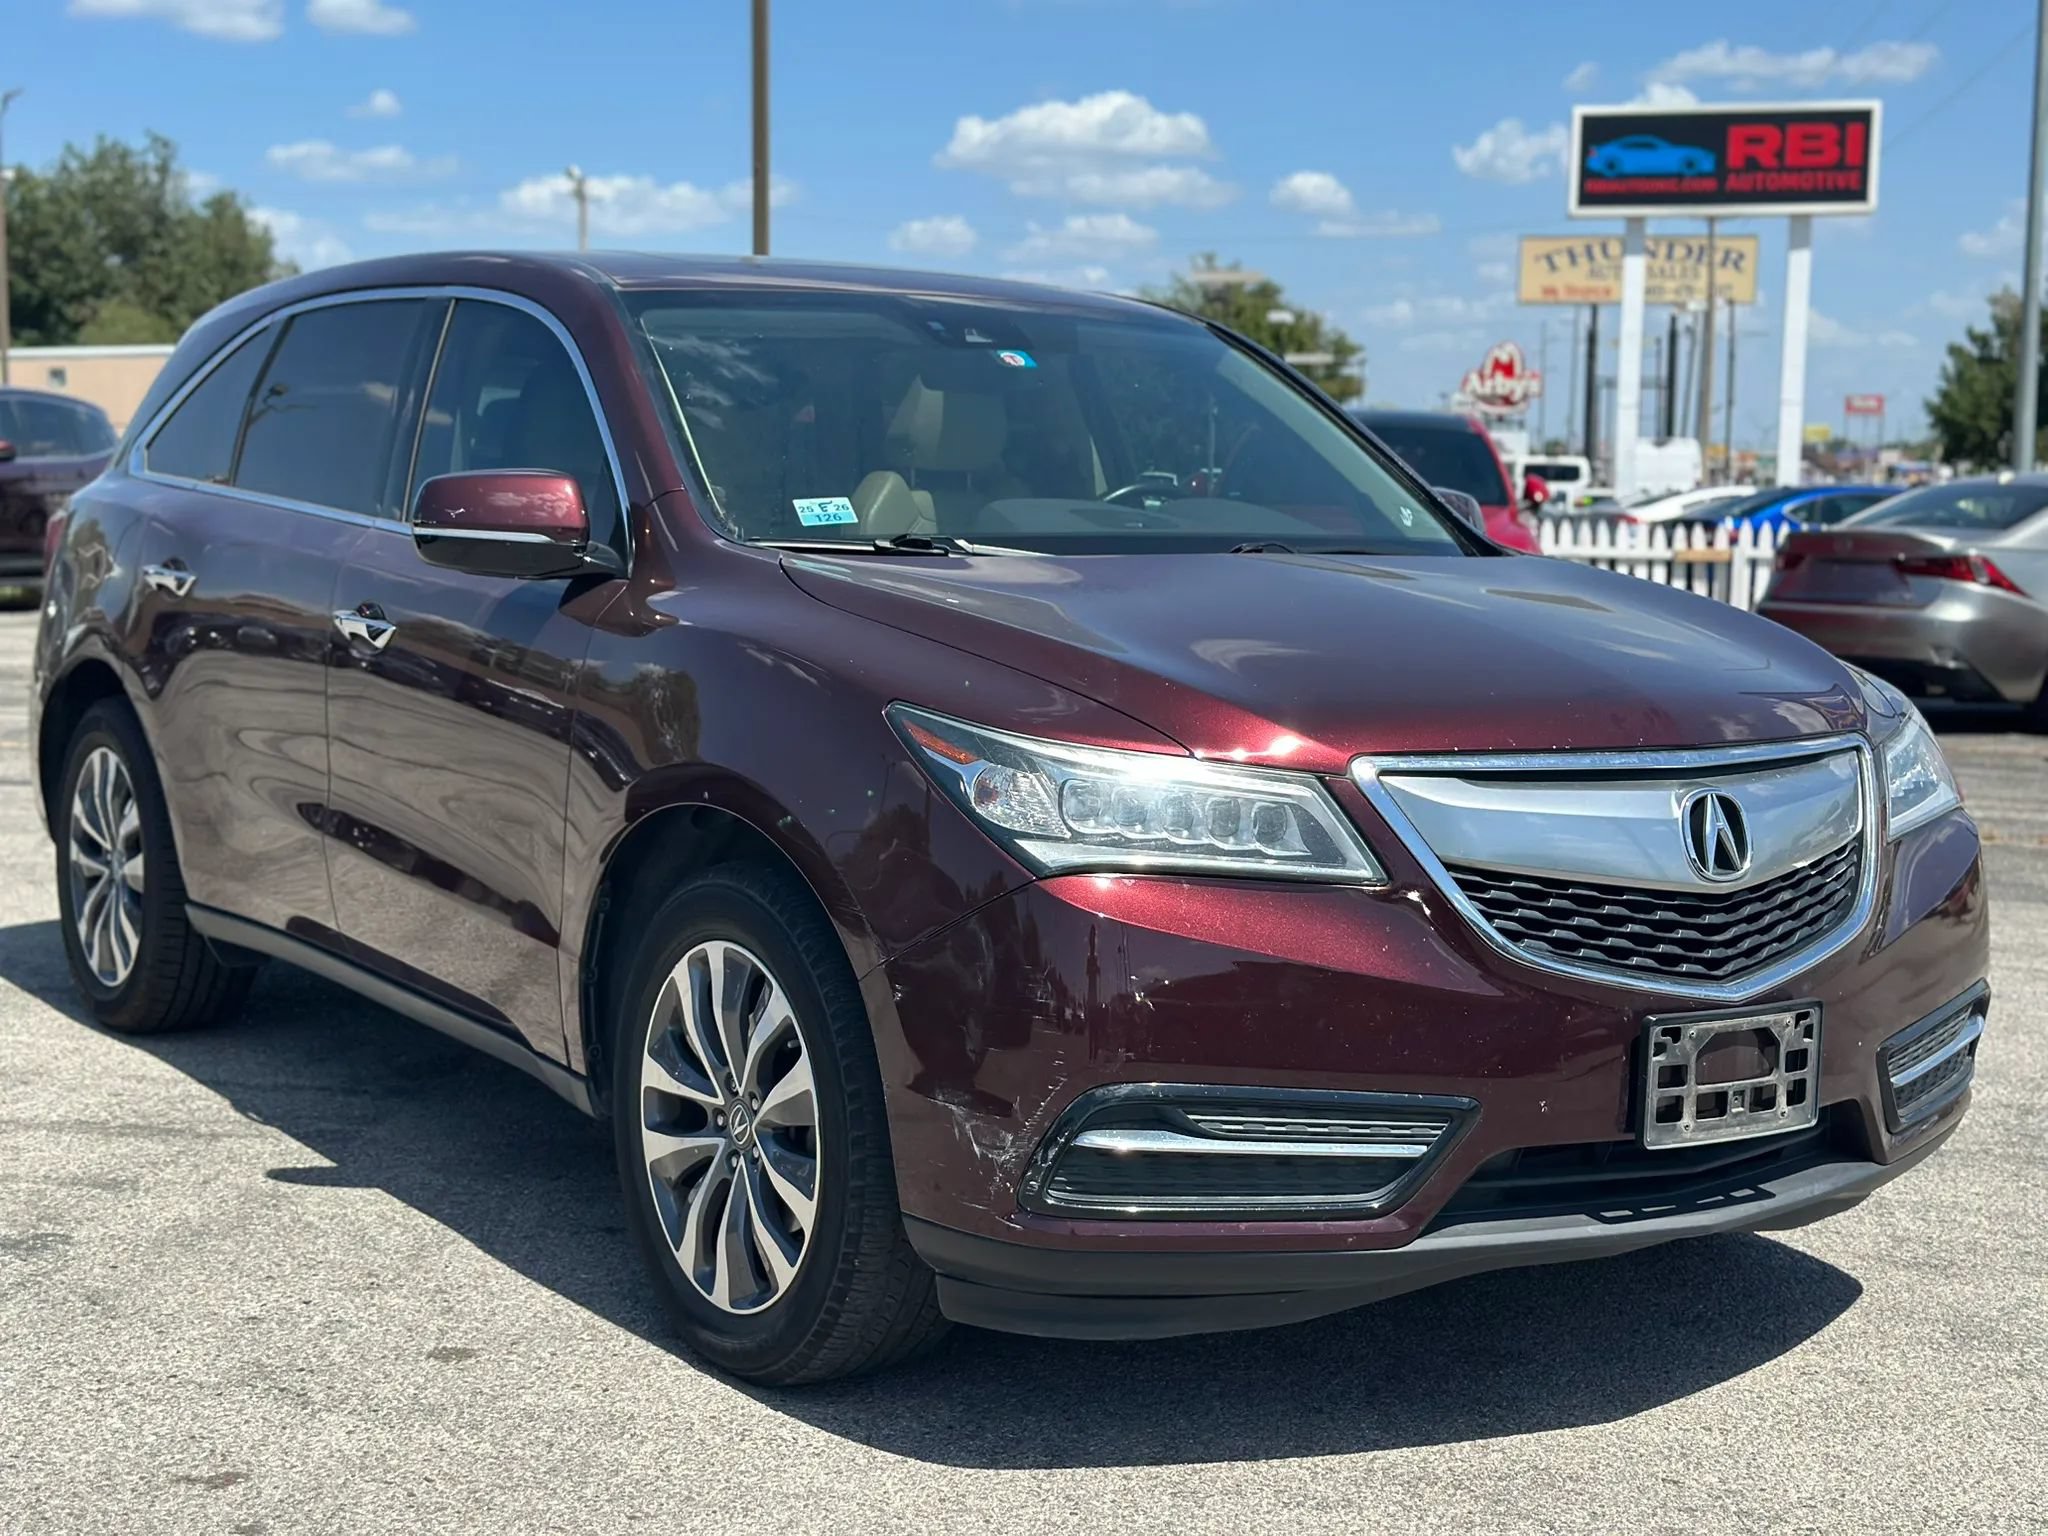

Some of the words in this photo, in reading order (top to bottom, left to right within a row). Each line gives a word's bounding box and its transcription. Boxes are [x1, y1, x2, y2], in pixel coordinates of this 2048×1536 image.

[1727, 122, 1865, 169] RBI
[1726, 170, 1861, 192] AUTOMOTIVE
[798, 505, 814, 513] 25
[833, 503, 849, 511] 26
[815, 513, 842, 522] 126
